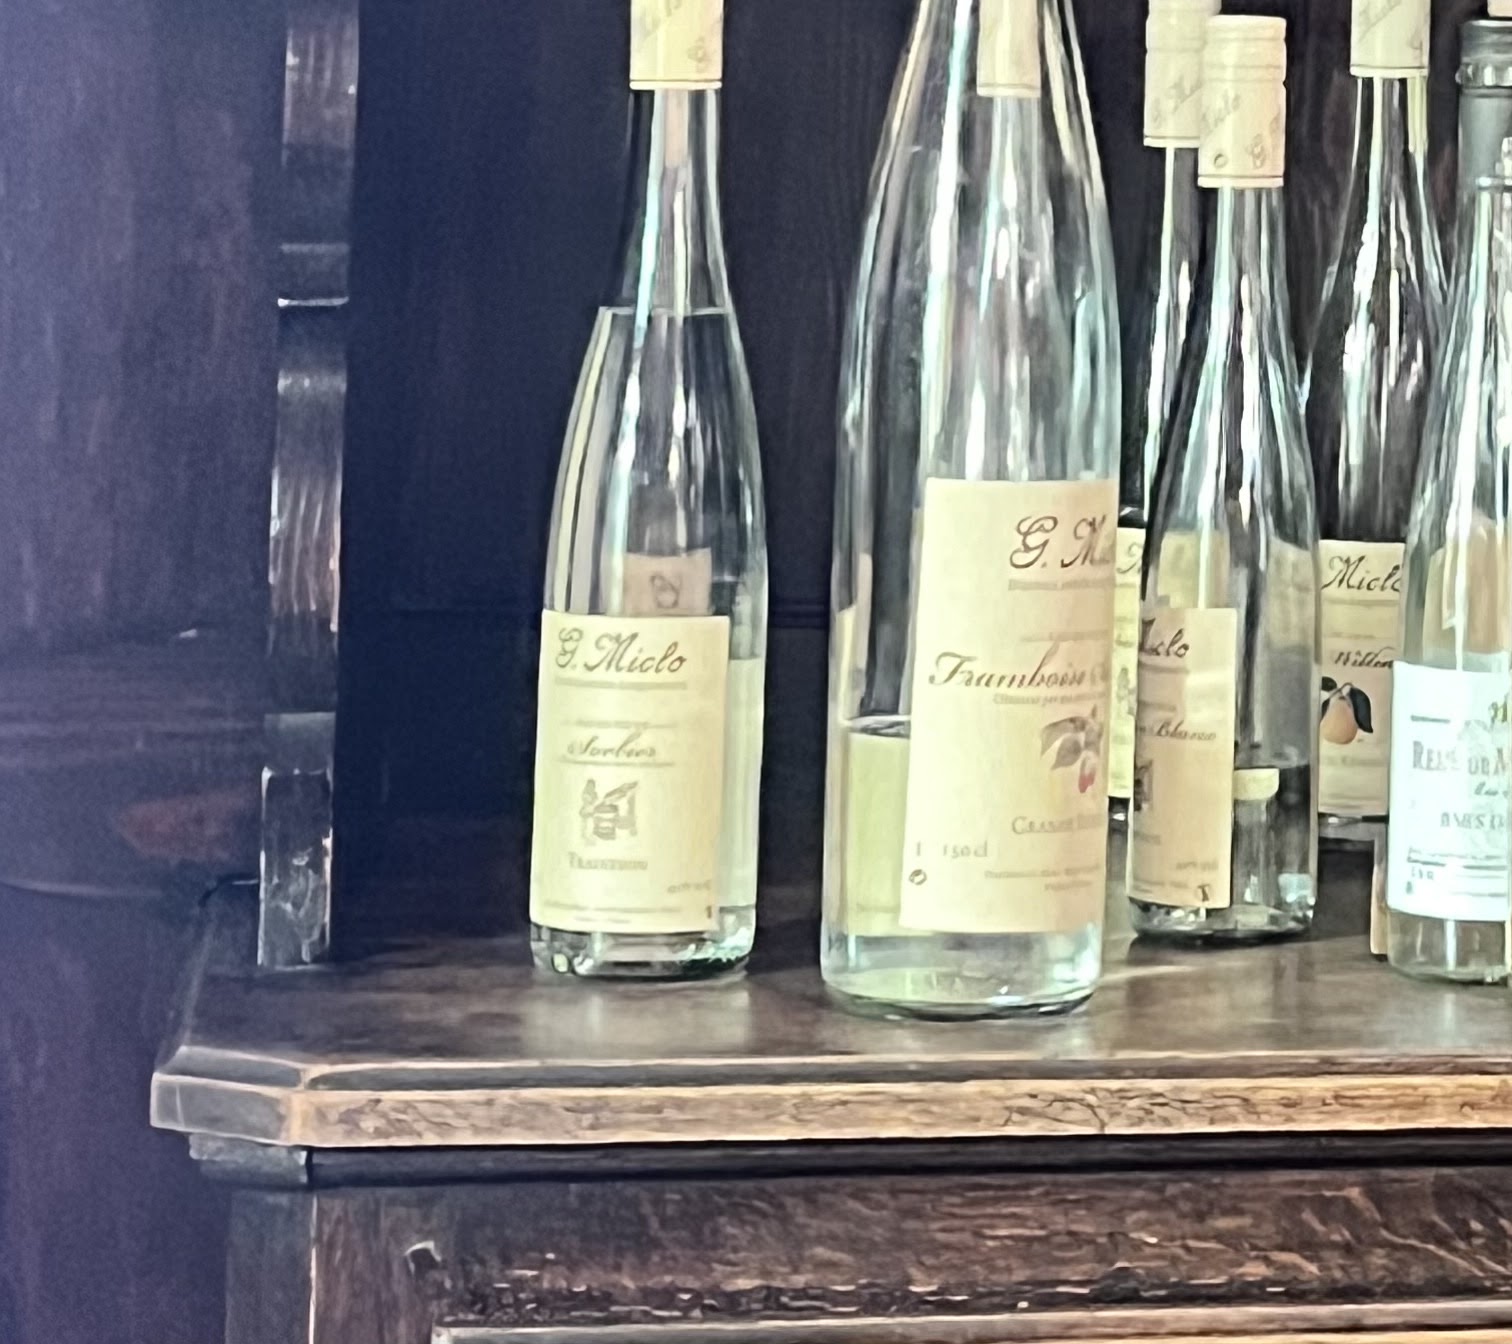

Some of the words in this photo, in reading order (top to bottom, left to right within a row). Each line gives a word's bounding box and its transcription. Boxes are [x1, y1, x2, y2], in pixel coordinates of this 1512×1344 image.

[1009, 515, 1058, 570] G.
[555, 627, 584, 670] G.
[583, 631, 687, 674] Miclo
